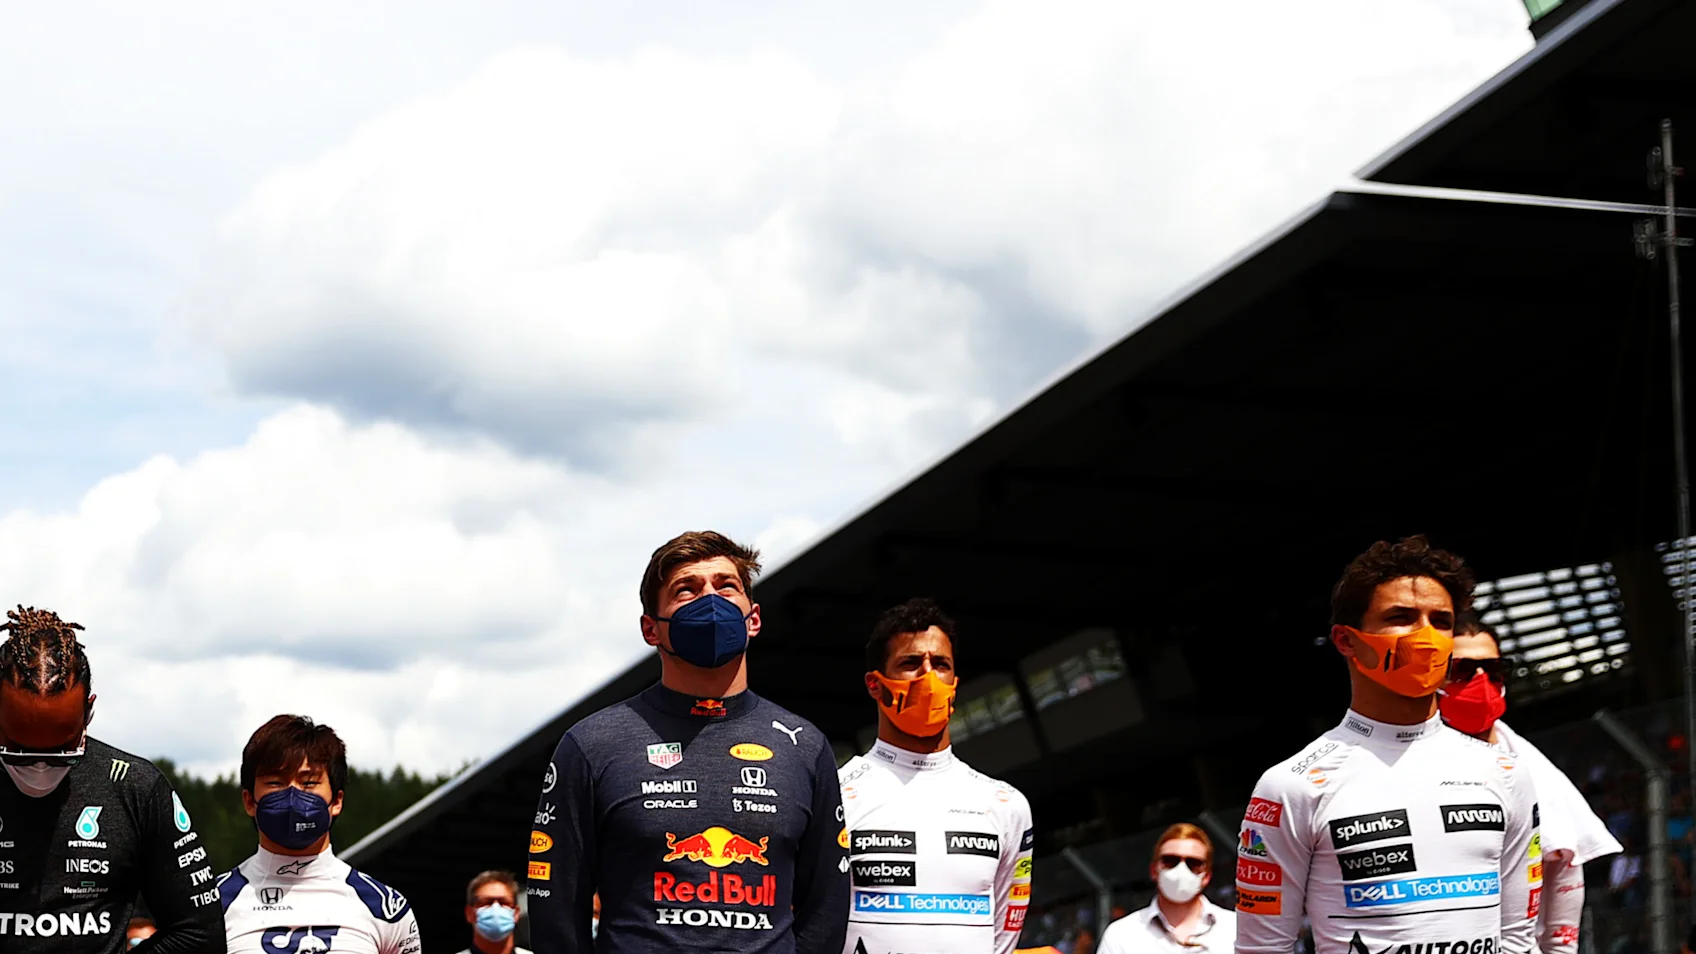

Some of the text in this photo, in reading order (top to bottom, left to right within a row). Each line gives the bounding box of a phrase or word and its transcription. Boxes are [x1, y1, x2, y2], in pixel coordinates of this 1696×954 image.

[1347, 720, 1370, 735] Hilton
[649, 744, 679, 754] TAG
[741, 748, 768, 756] RAUCH
[876, 749, 894, 762] Hilton
[650, 754, 682, 763] HEUER
[1290, 742, 1337, 774] sparco
[642, 780, 682, 794] Mobil
[732, 786, 778, 796] HONDA
[644, 799, 698, 809] ORACLE
[744, 799, 777, 813] Tezos
[68, 840, 107, 849] PETRONAS
[66, 858, 110, 874] INEOS
[1344, 849, 1409, 870] webex
[190, 865, 213, 886] IWC
[856, 862, 911, 877] webex
[64, 886, 87, 894] Hewlett
[535, 888, 551, 898] App
[654, 871, 776, 906] Red Bull
[1350, 882, 1406, 903] DELL
[858, 893, 989, 914] DELL Technologies
[655, 907, 773, 930] HONDA
